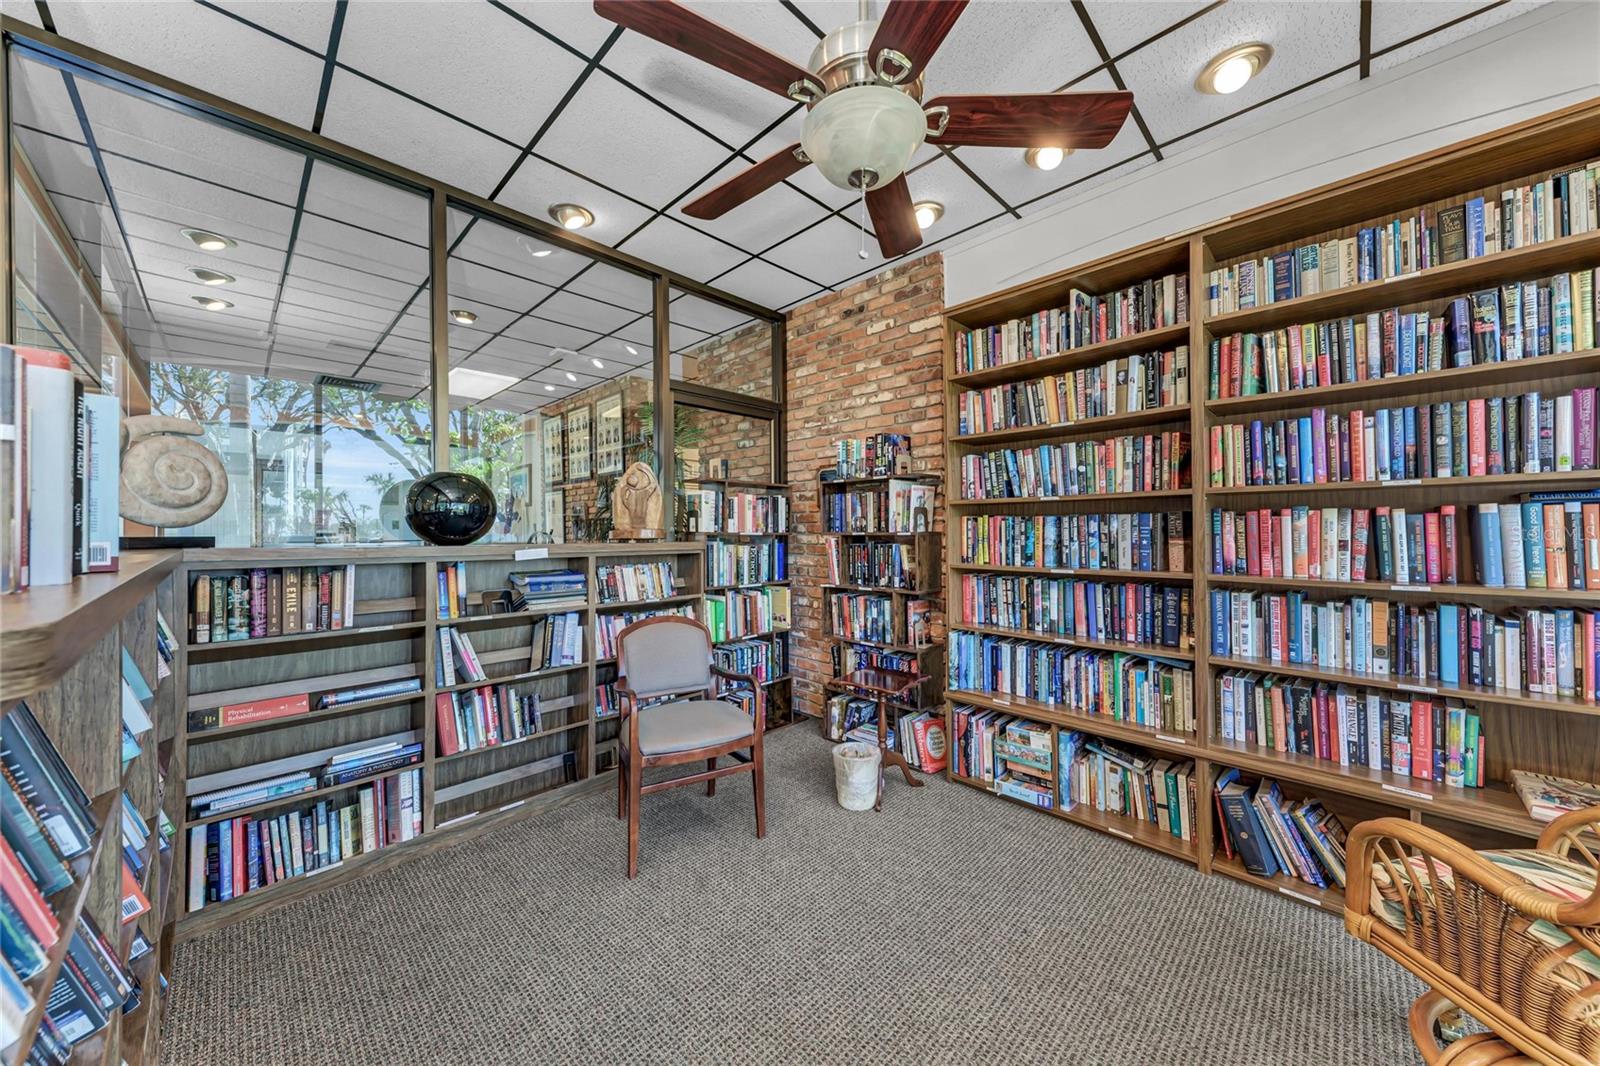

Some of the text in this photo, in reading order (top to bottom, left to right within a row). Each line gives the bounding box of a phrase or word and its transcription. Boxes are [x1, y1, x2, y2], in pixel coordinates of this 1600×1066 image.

[1301, 247, 1310, 272] MILLER
[1529, 506, 1539, 523] Good
[1531, 546, 1541, 563] Irene
[286, 587, 297, 613] EXILE
[1347, 708, 1357, 739] TRIANGLE
[1393, 714, 1405, 736] PACIFIC
